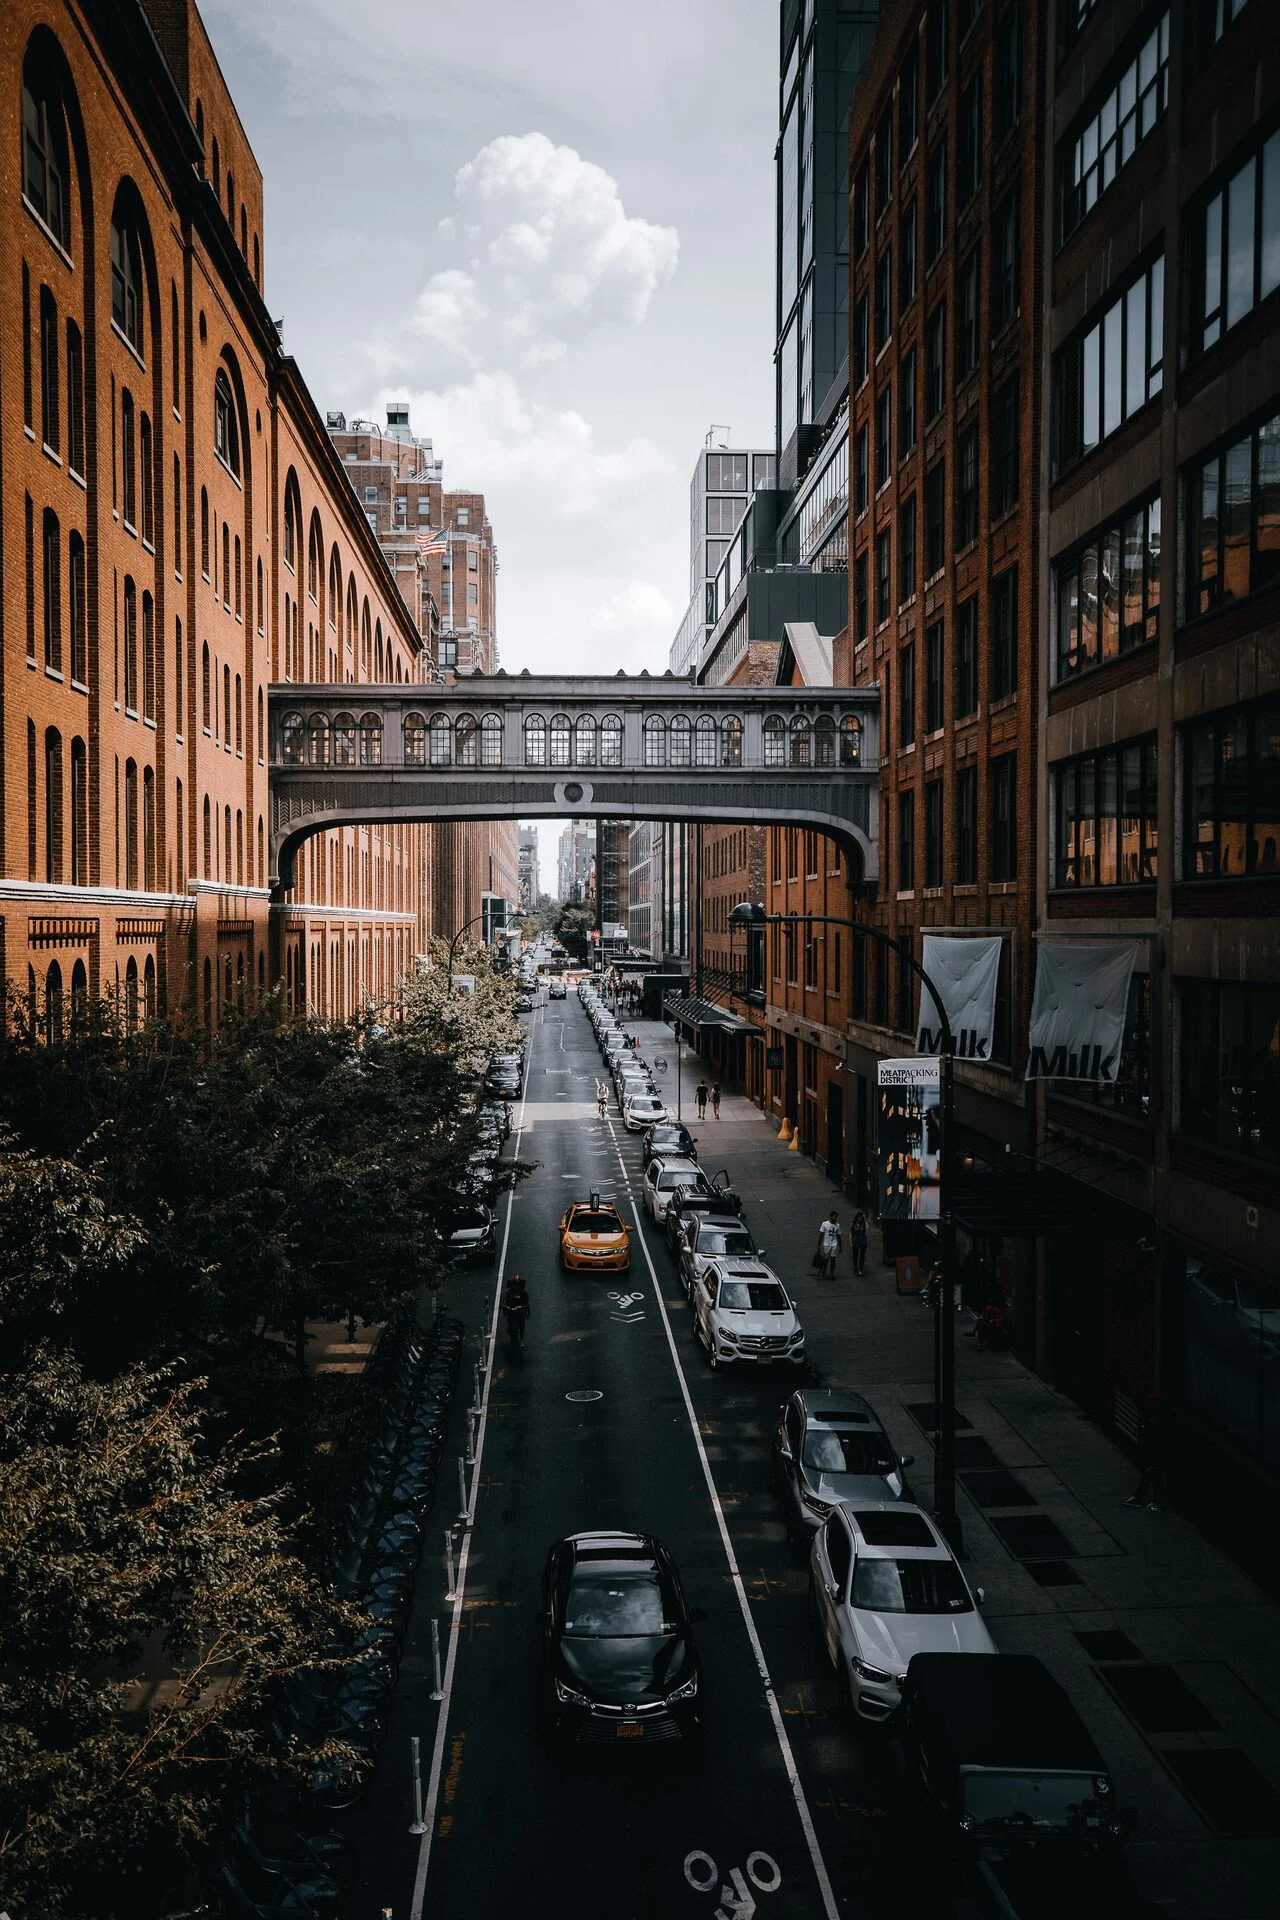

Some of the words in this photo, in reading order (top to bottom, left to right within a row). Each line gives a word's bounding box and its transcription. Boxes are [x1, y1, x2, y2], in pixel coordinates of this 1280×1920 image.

[1030, 1044, 1116, 1081] Milk
[880, 1069, 938, 1078] MEATPACKING
[880, 1076, 914, 1084] DISTRICT
